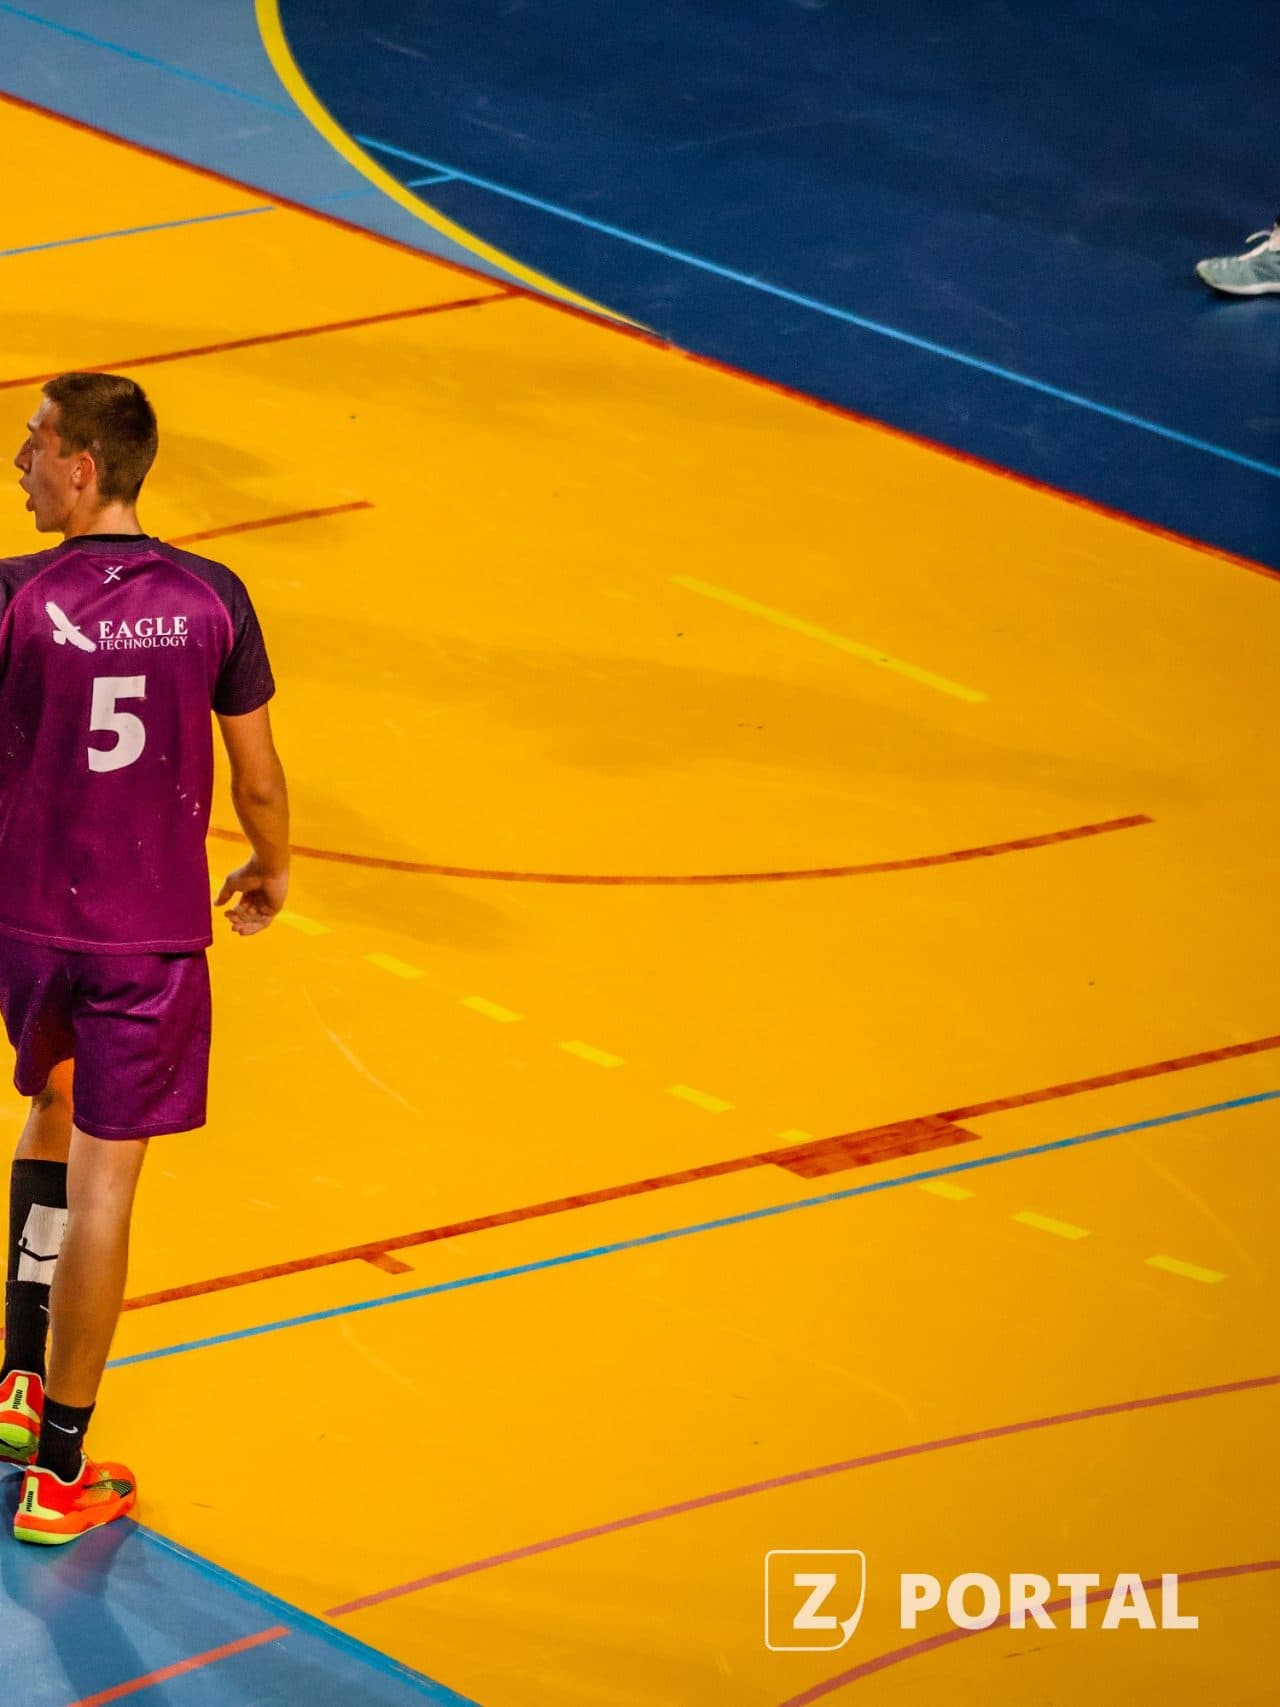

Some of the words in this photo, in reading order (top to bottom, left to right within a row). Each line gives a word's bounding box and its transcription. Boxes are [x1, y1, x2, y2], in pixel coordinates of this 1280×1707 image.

[98, 616, 188, 639] EAGLE
[98, 636, 187, 650] TECHNOLOGY
[87, 675, 146, 773] 5
